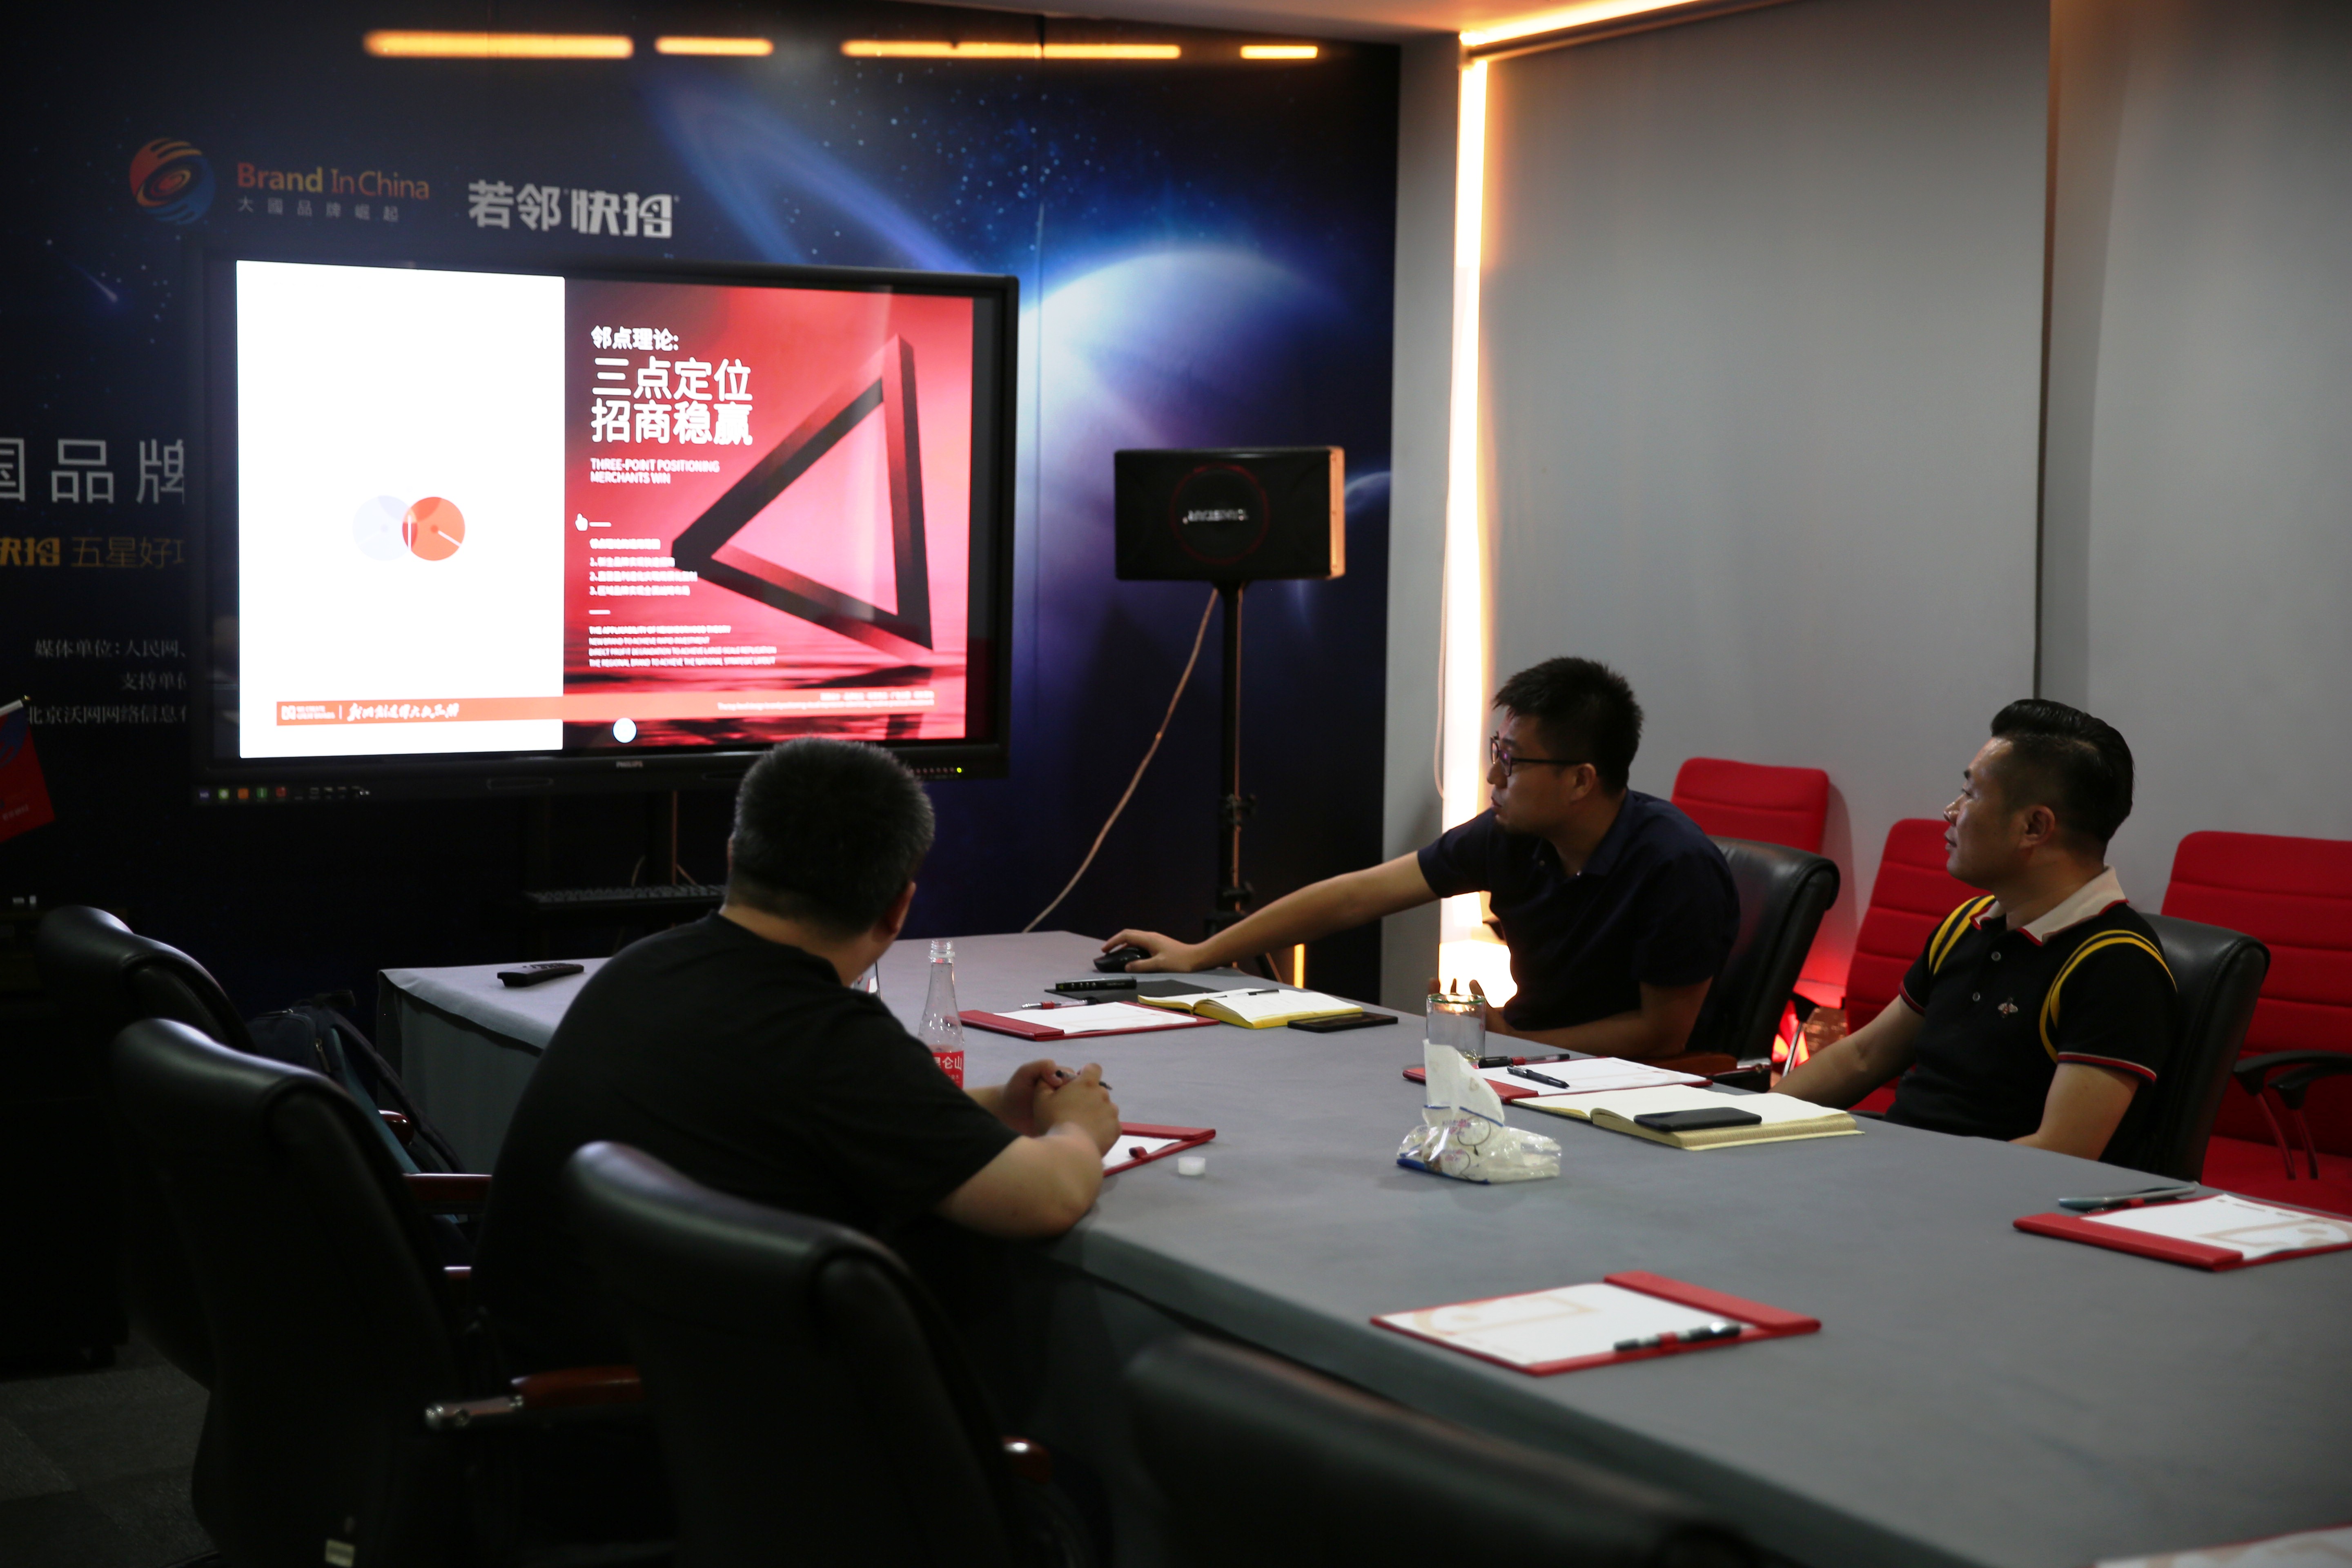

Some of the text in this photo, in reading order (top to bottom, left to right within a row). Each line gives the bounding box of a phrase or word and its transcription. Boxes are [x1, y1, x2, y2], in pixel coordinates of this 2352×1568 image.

[237, 163, 323, 194] Brand
[238, 196, 399, 223] 大國品牌崛起
[592, 355, 753, 402] 三点定位
[590, 397, 753, 446] 招商稳赢
[590, 458, 720, 473] THREE-POINT POSITIONING
[590, 471, 671, 484] MERCHANTS WIN
